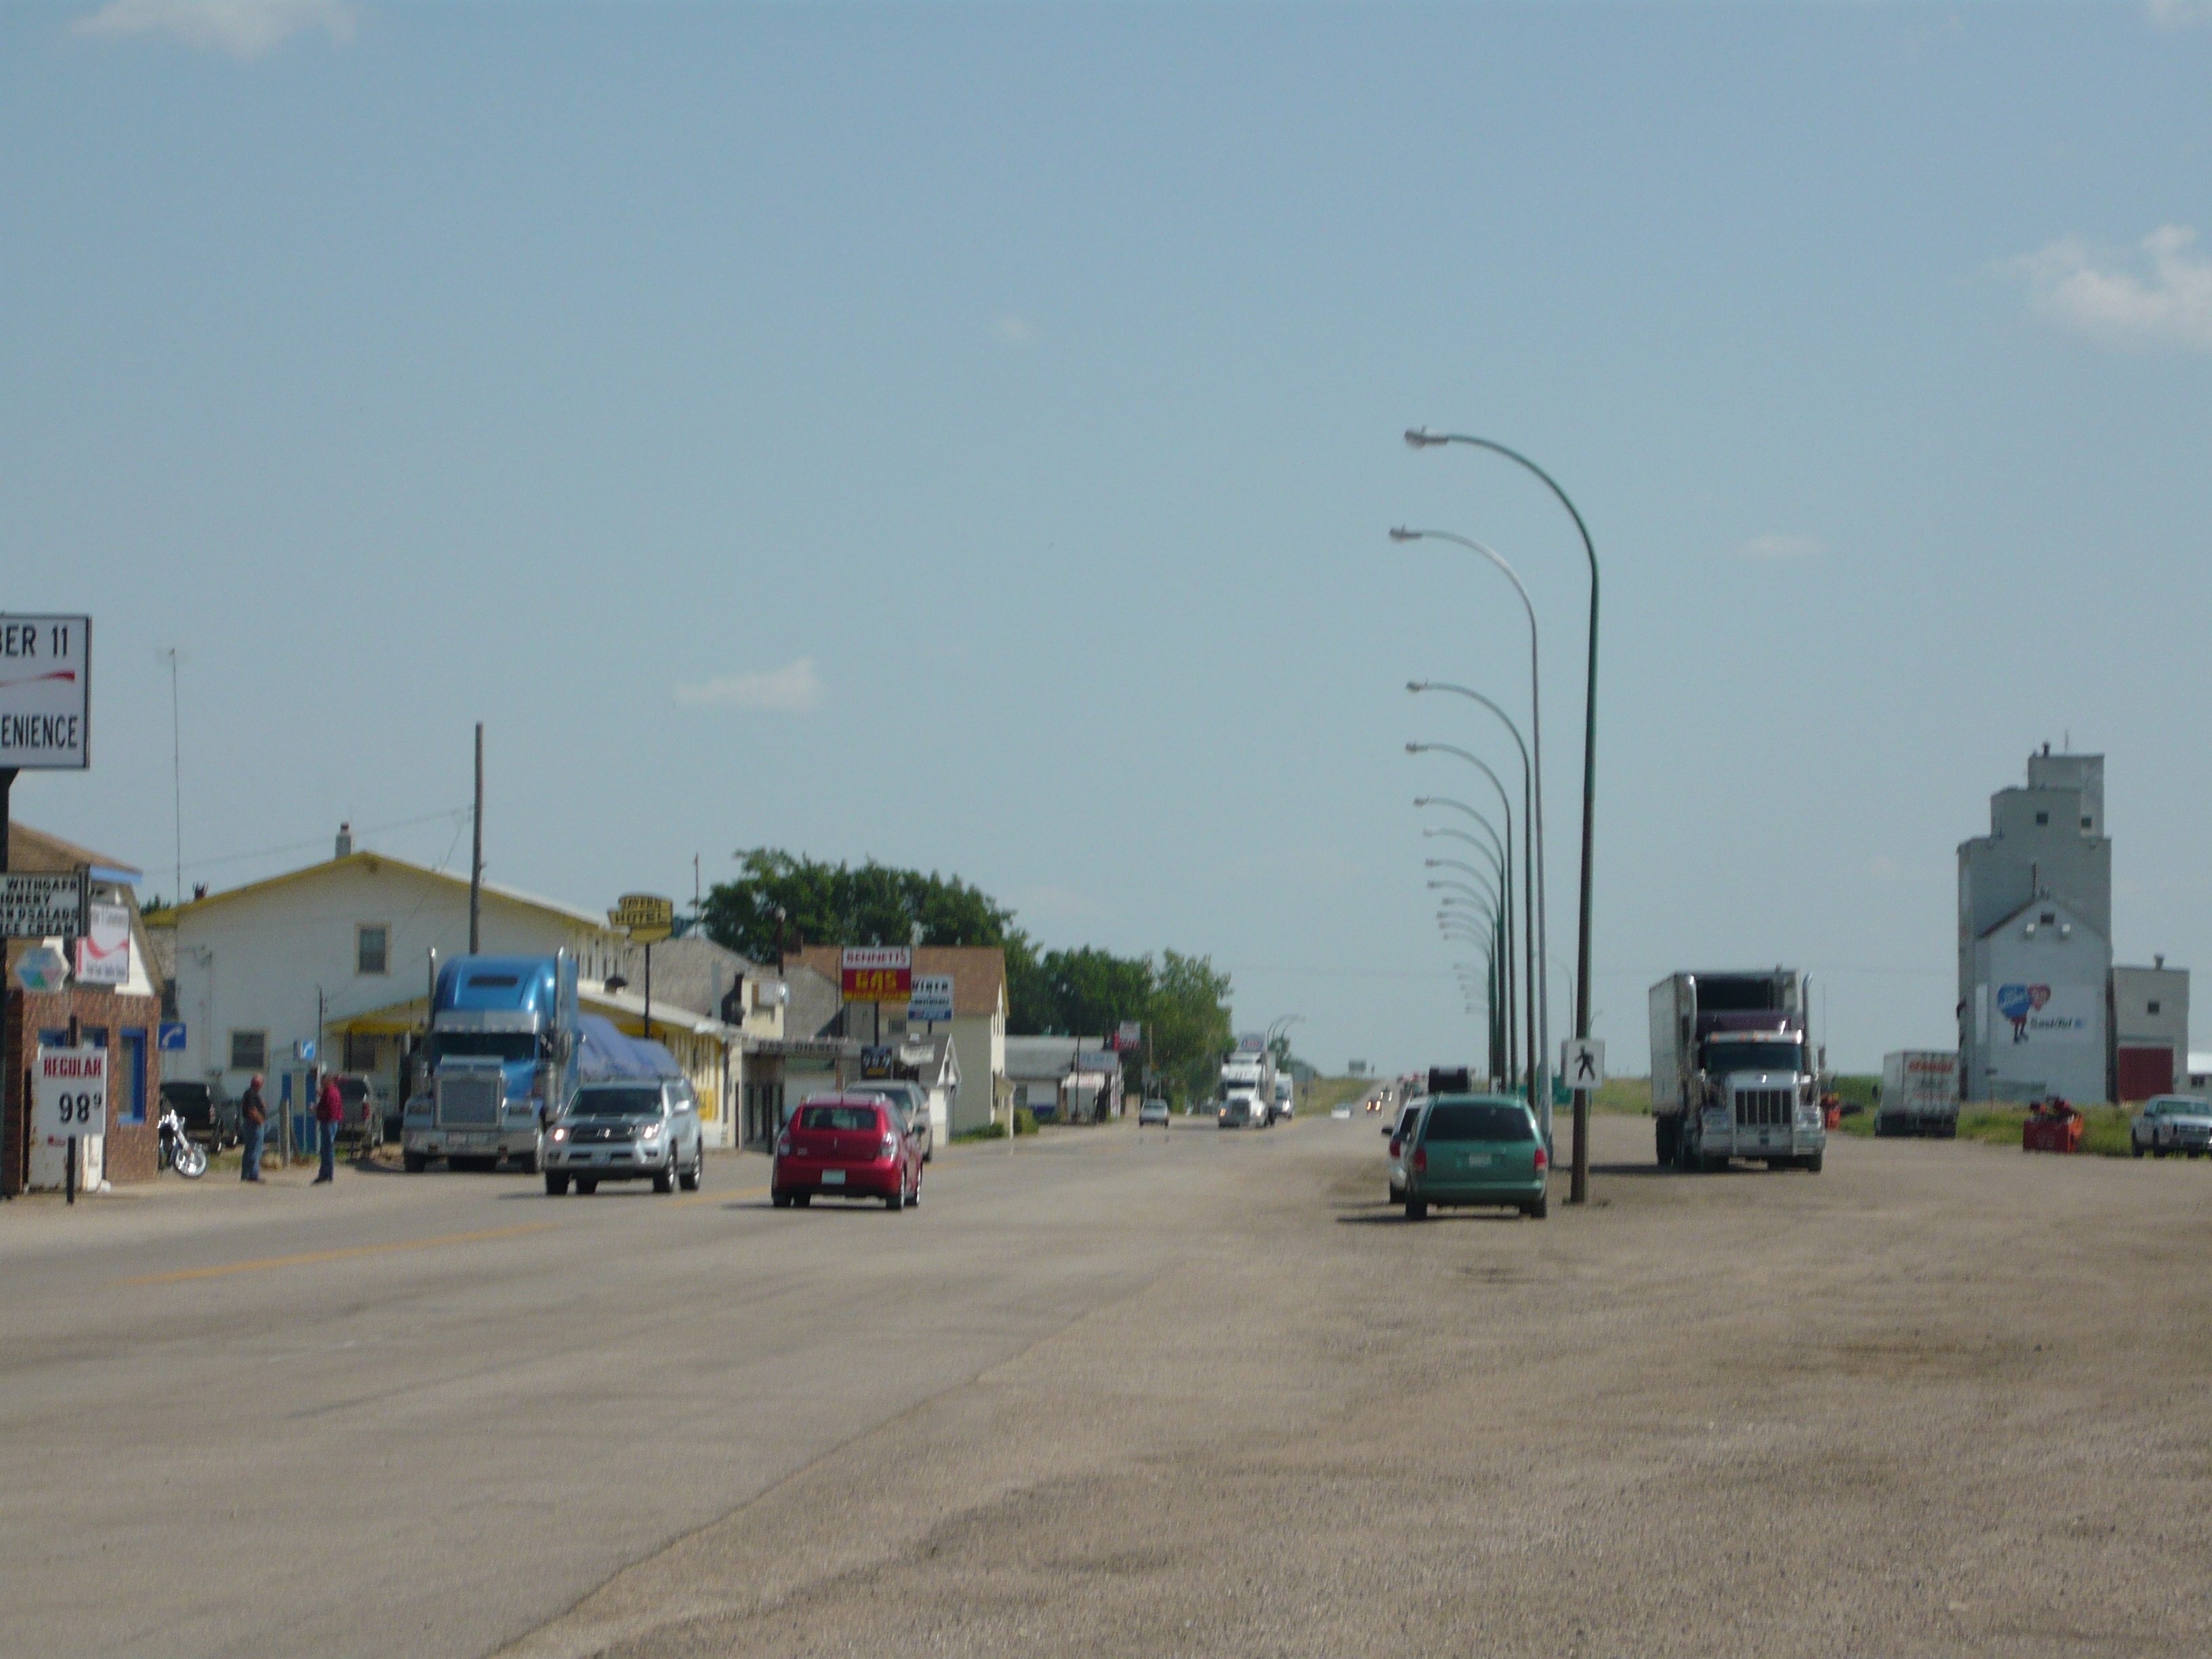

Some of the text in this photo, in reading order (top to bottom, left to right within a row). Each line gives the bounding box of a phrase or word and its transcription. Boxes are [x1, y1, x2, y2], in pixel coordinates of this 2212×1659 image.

[0, 625, 68, 657] ER 11
[2, 714, 78, 748] ENIENCE
[43, 1057, 102, 1078] REGULAR
